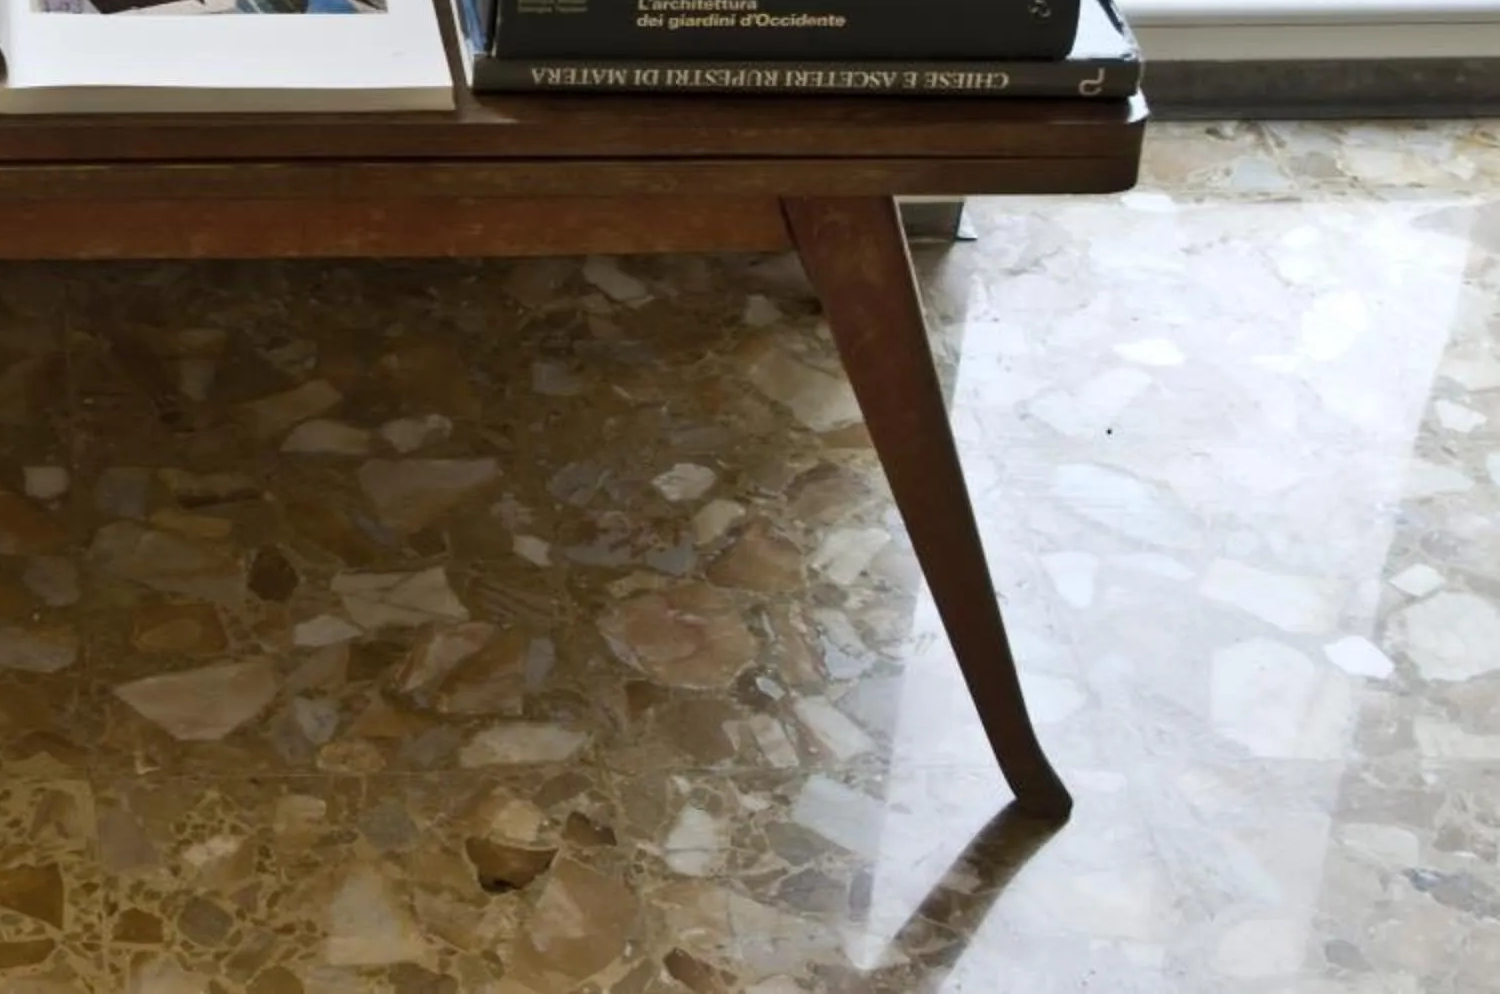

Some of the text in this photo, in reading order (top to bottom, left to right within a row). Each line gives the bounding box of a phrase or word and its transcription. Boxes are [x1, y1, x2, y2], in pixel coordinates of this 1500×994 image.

[637, 13, 846, 30] dei giardini d'Occidente
[531, 68, 1009, 89] CHIESE E ASCETERI RUPESTRI DI MATERA
